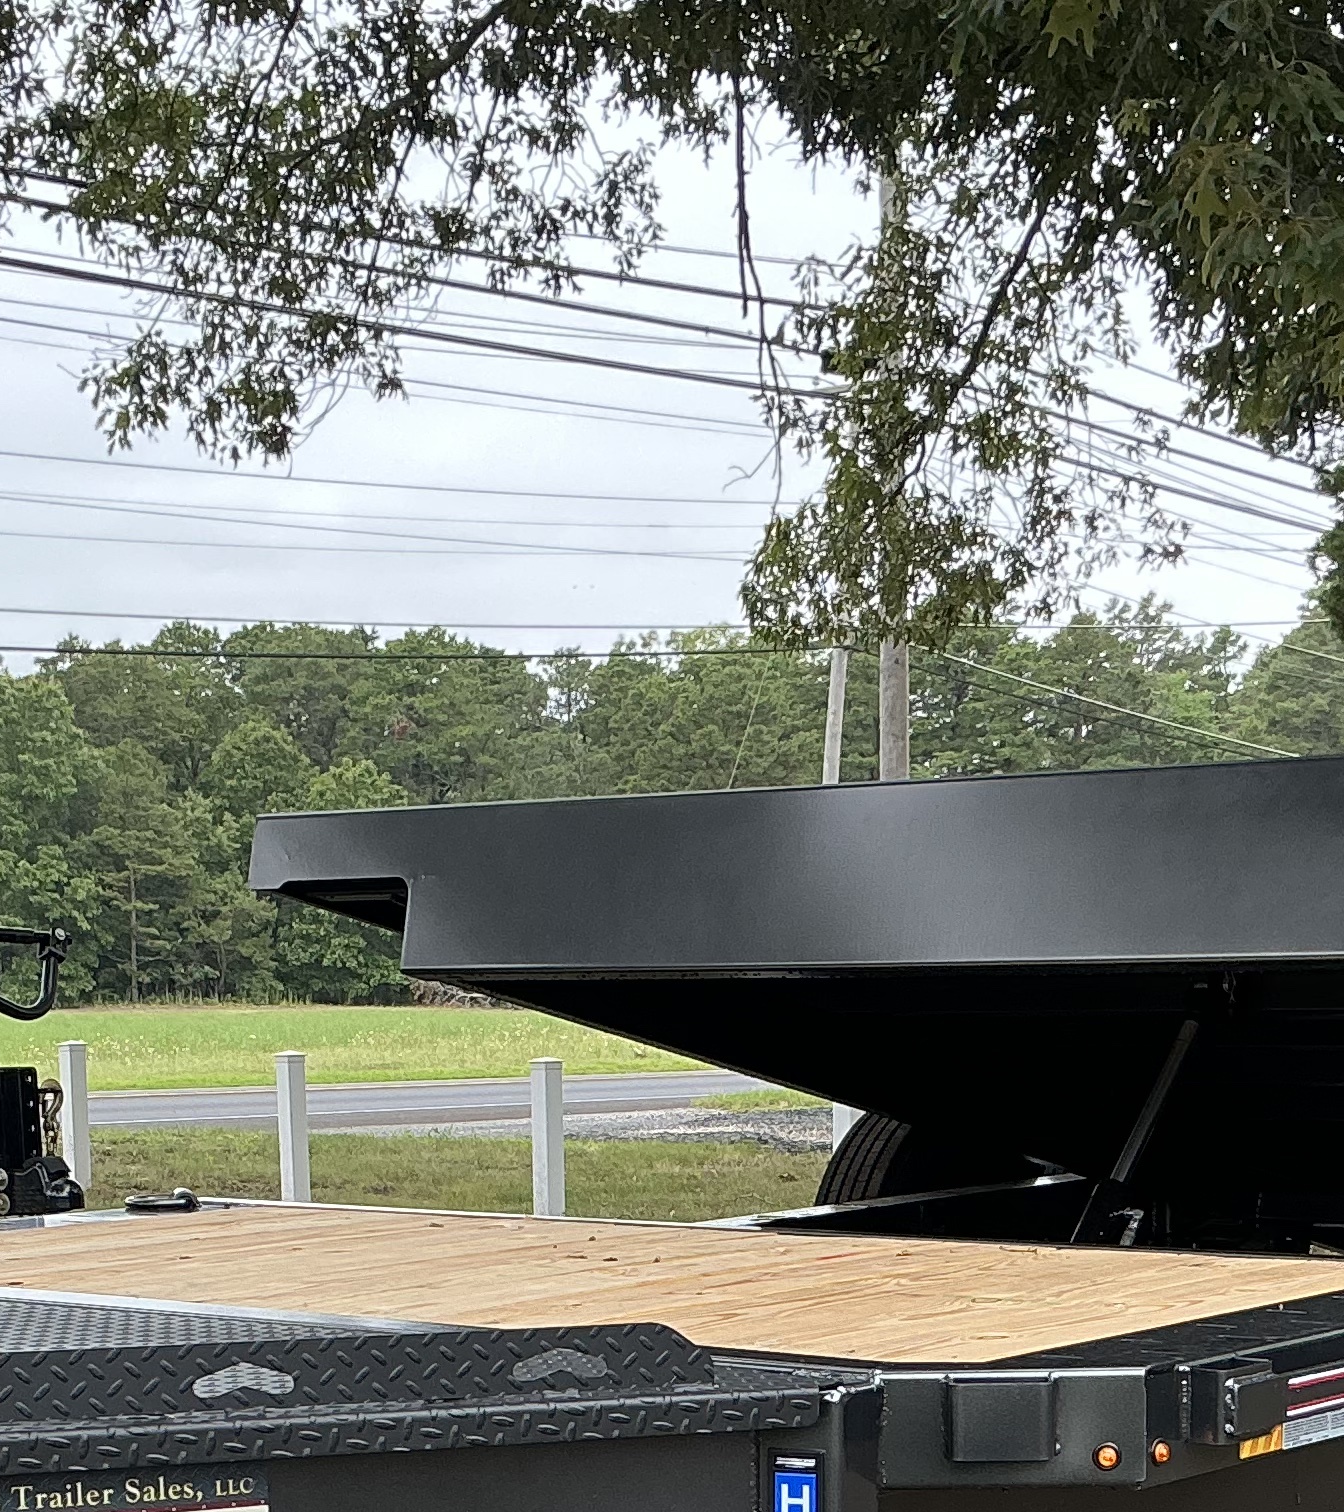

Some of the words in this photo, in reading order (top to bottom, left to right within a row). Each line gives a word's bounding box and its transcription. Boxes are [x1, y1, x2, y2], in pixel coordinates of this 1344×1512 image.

[11, 1481, 115, 1511] Trailer
[125, 1476, 203, 1503] Sales,
[215, 1477, 255, 1497] LLC
